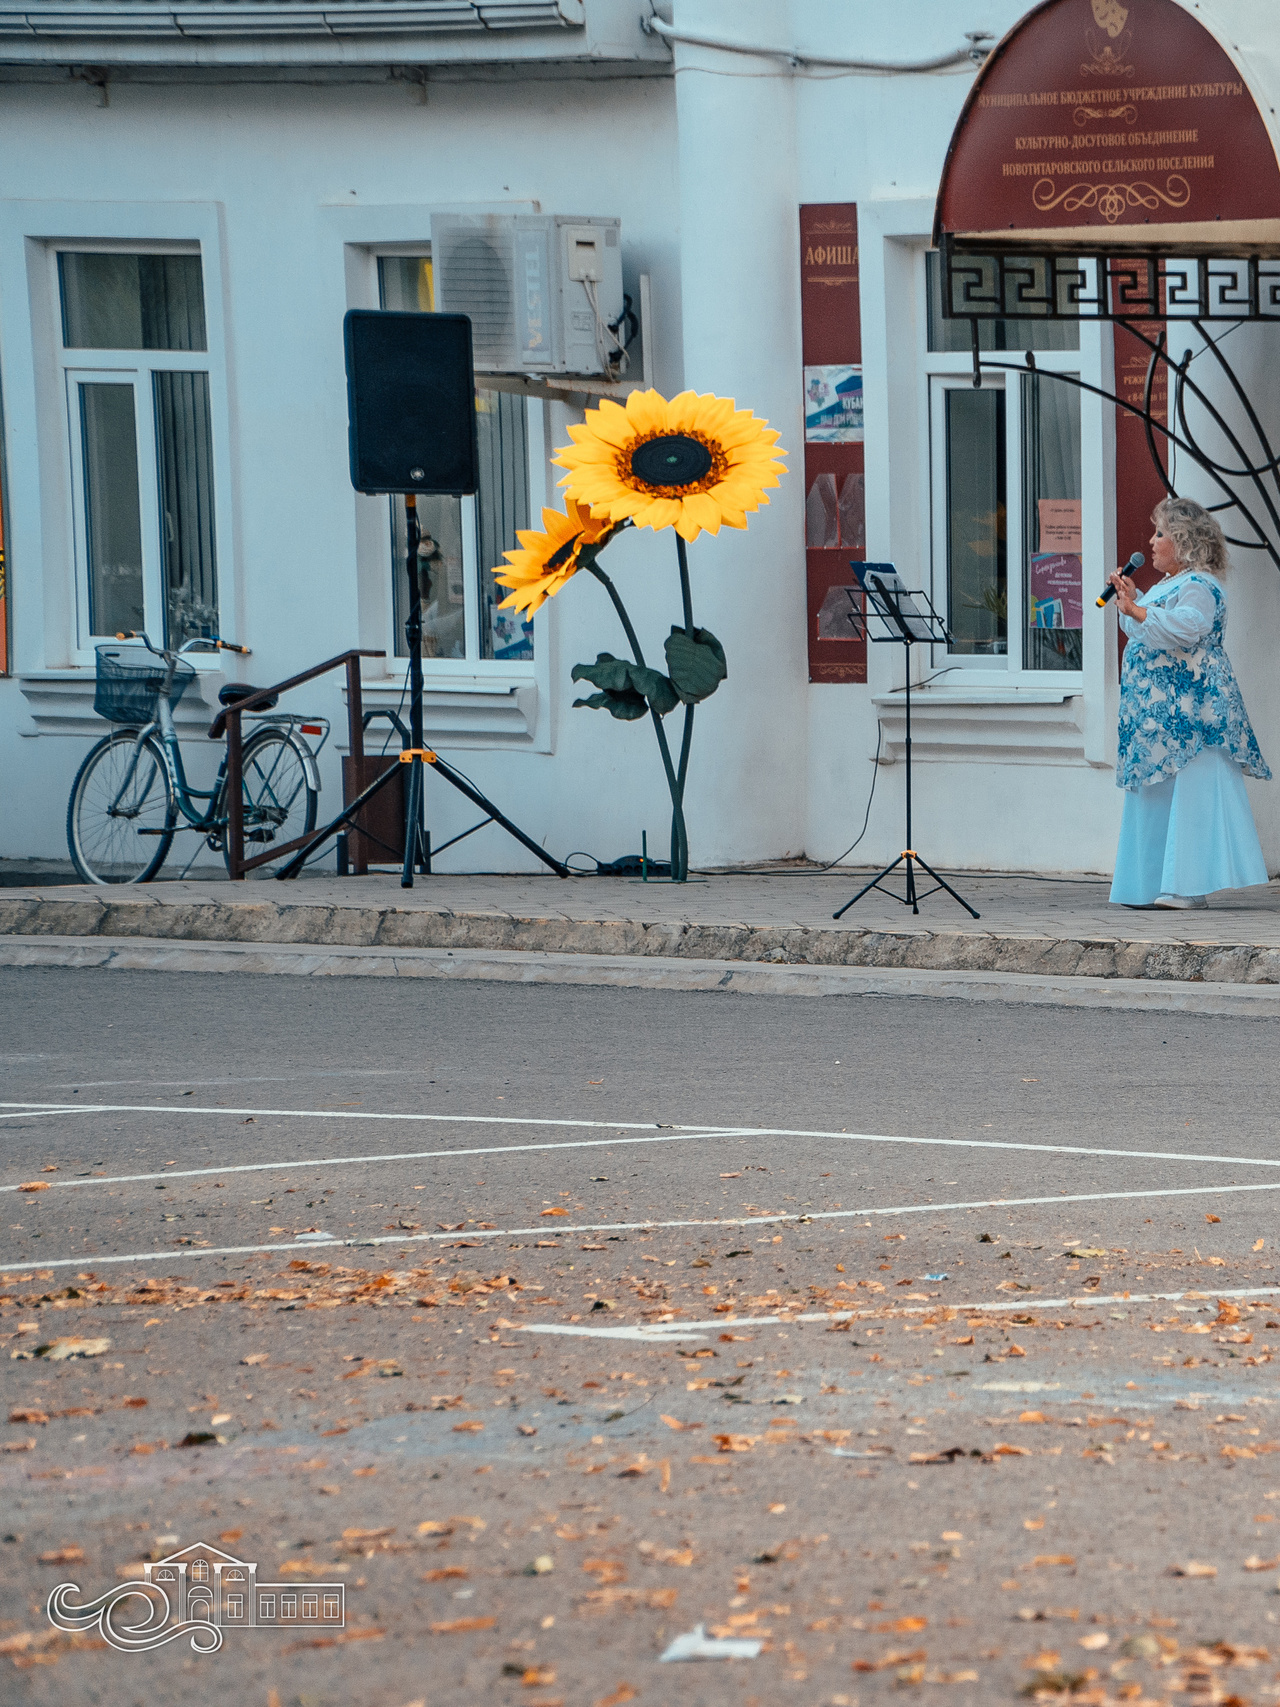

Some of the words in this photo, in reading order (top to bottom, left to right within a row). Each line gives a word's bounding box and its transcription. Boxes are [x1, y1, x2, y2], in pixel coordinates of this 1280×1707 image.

[979, 91, 1059, 107] МУНИЦИПАЛЬНОЕ
[1061, 88, 1120, 105] БЮДЖЕТНОЕ
[1123, 85, 1187, 101] УЧРЕЖДЕНИЕ
[1189, 82, 1243, 98] КУЛЬТУРЫ
[1015, 133, 1126, 150] КУЛЬТУРНО-ДОСУГОВОЕ
[1128, 129, 1198, 146] ОБЪЕДИНЕНИЕ
[1002, 161, 1100, 177] НОВОТИТАРОВСКОГО
[1102, 158, 1155, 173] СЕЛЬСКОГО
[1157, 155, 1214, 171] ПОСЕЛЕНИЯ
[805, 246, 858, 265] АФИША
